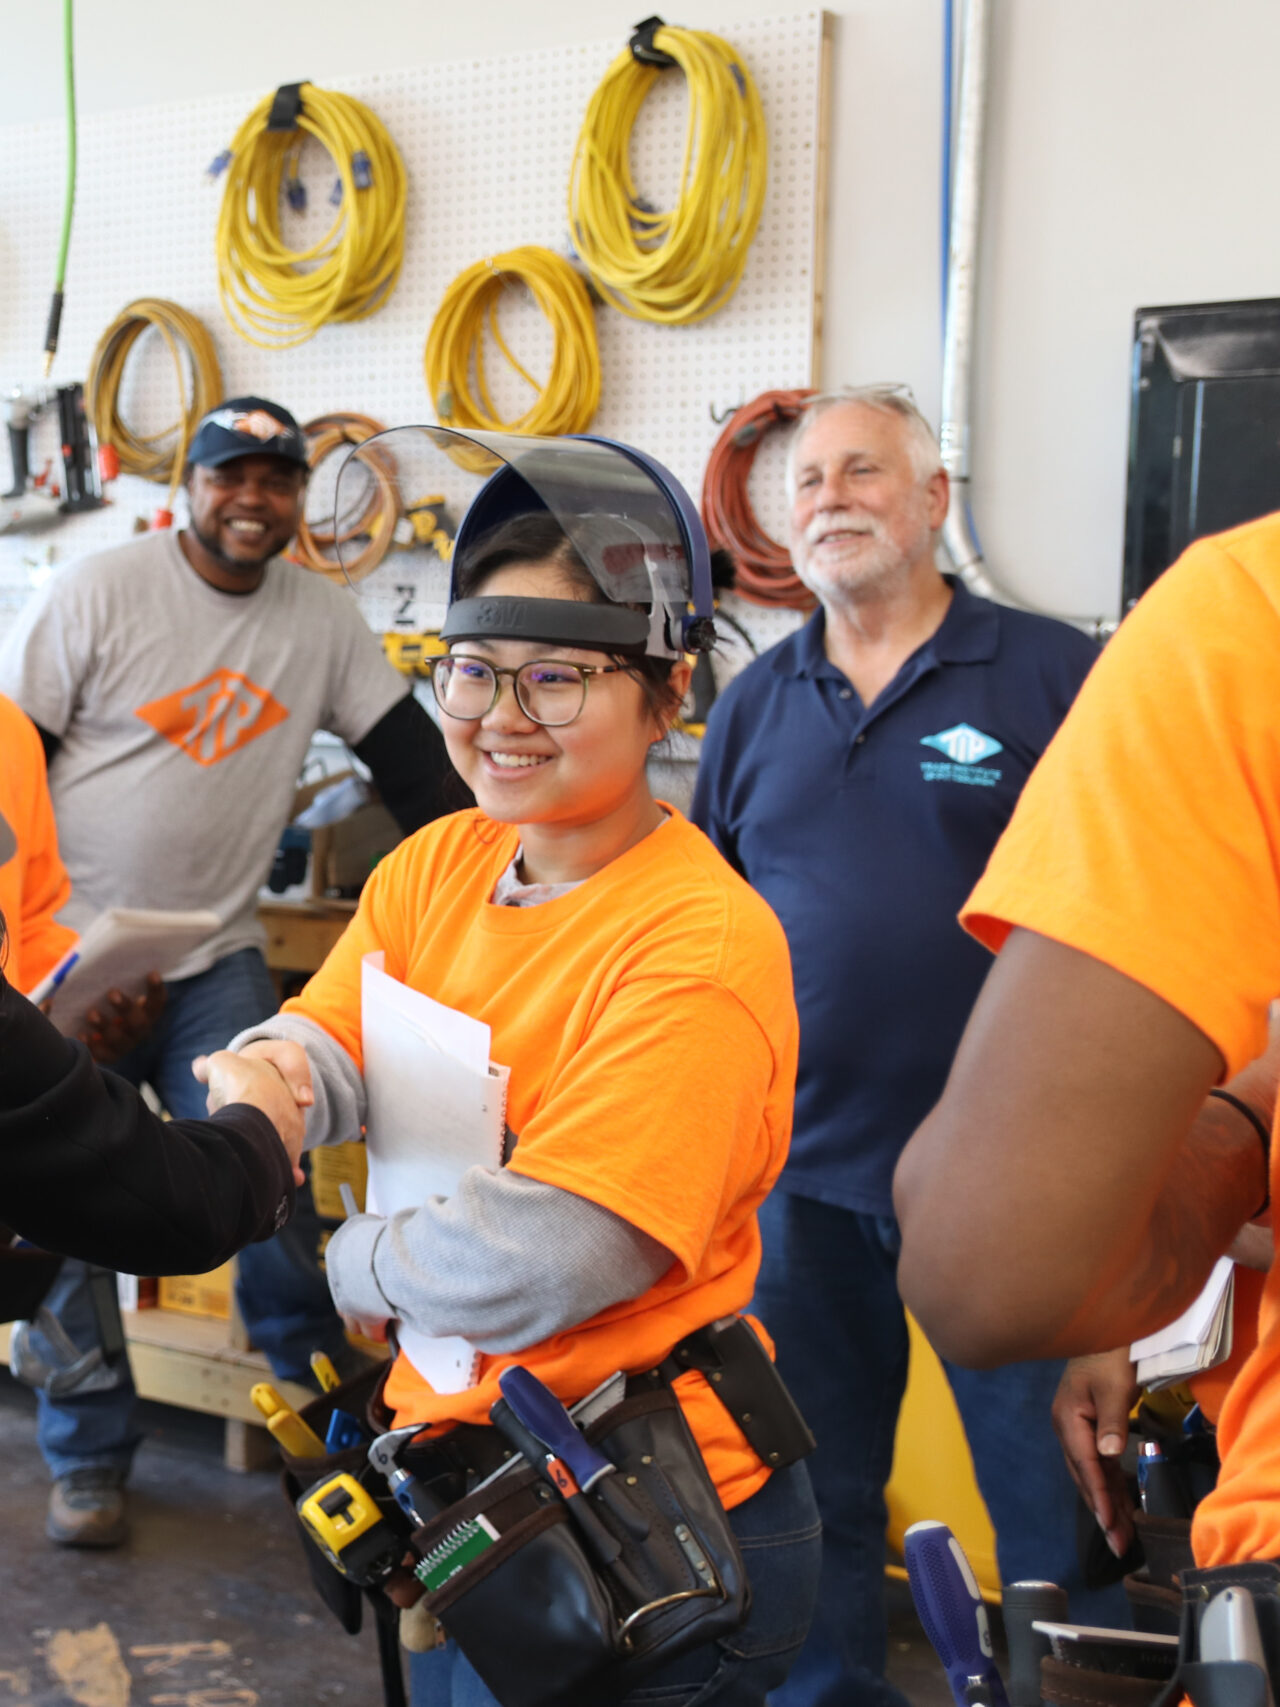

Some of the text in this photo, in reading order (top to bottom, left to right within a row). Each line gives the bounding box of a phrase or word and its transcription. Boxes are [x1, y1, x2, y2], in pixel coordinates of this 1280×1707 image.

[476, 600, 529, 629] 3M
[182, 678, 264, 760] TIP
[939, 727, 987, 763] TIP
[375, 1445, 389, 1466] 6
[556, 1468, 569, 1489] 6
